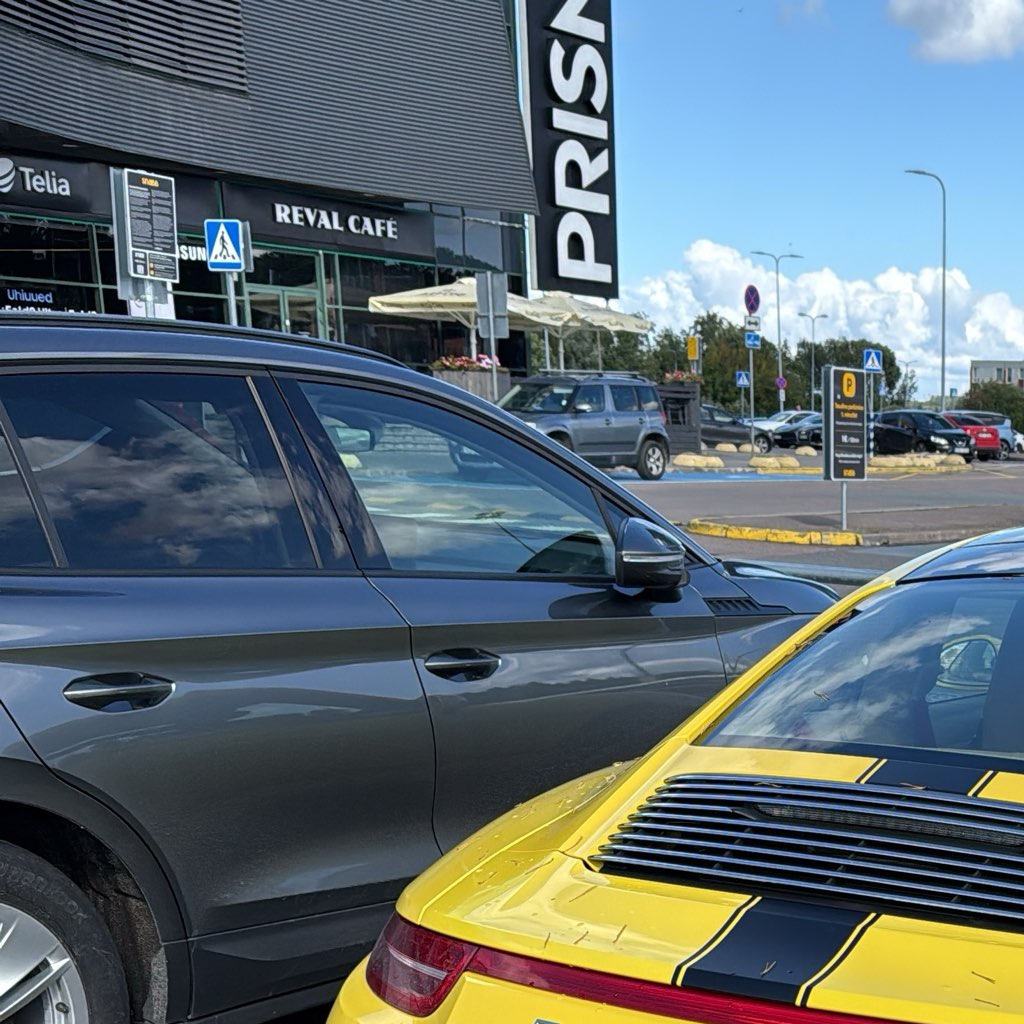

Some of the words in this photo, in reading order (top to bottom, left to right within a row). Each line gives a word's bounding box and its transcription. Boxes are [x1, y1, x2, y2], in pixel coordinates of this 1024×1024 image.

[18, 166, 71, 196] Telia
[274, 203, 344, 232] REVAL
[347, 215, 398, 239] CAFÉ
